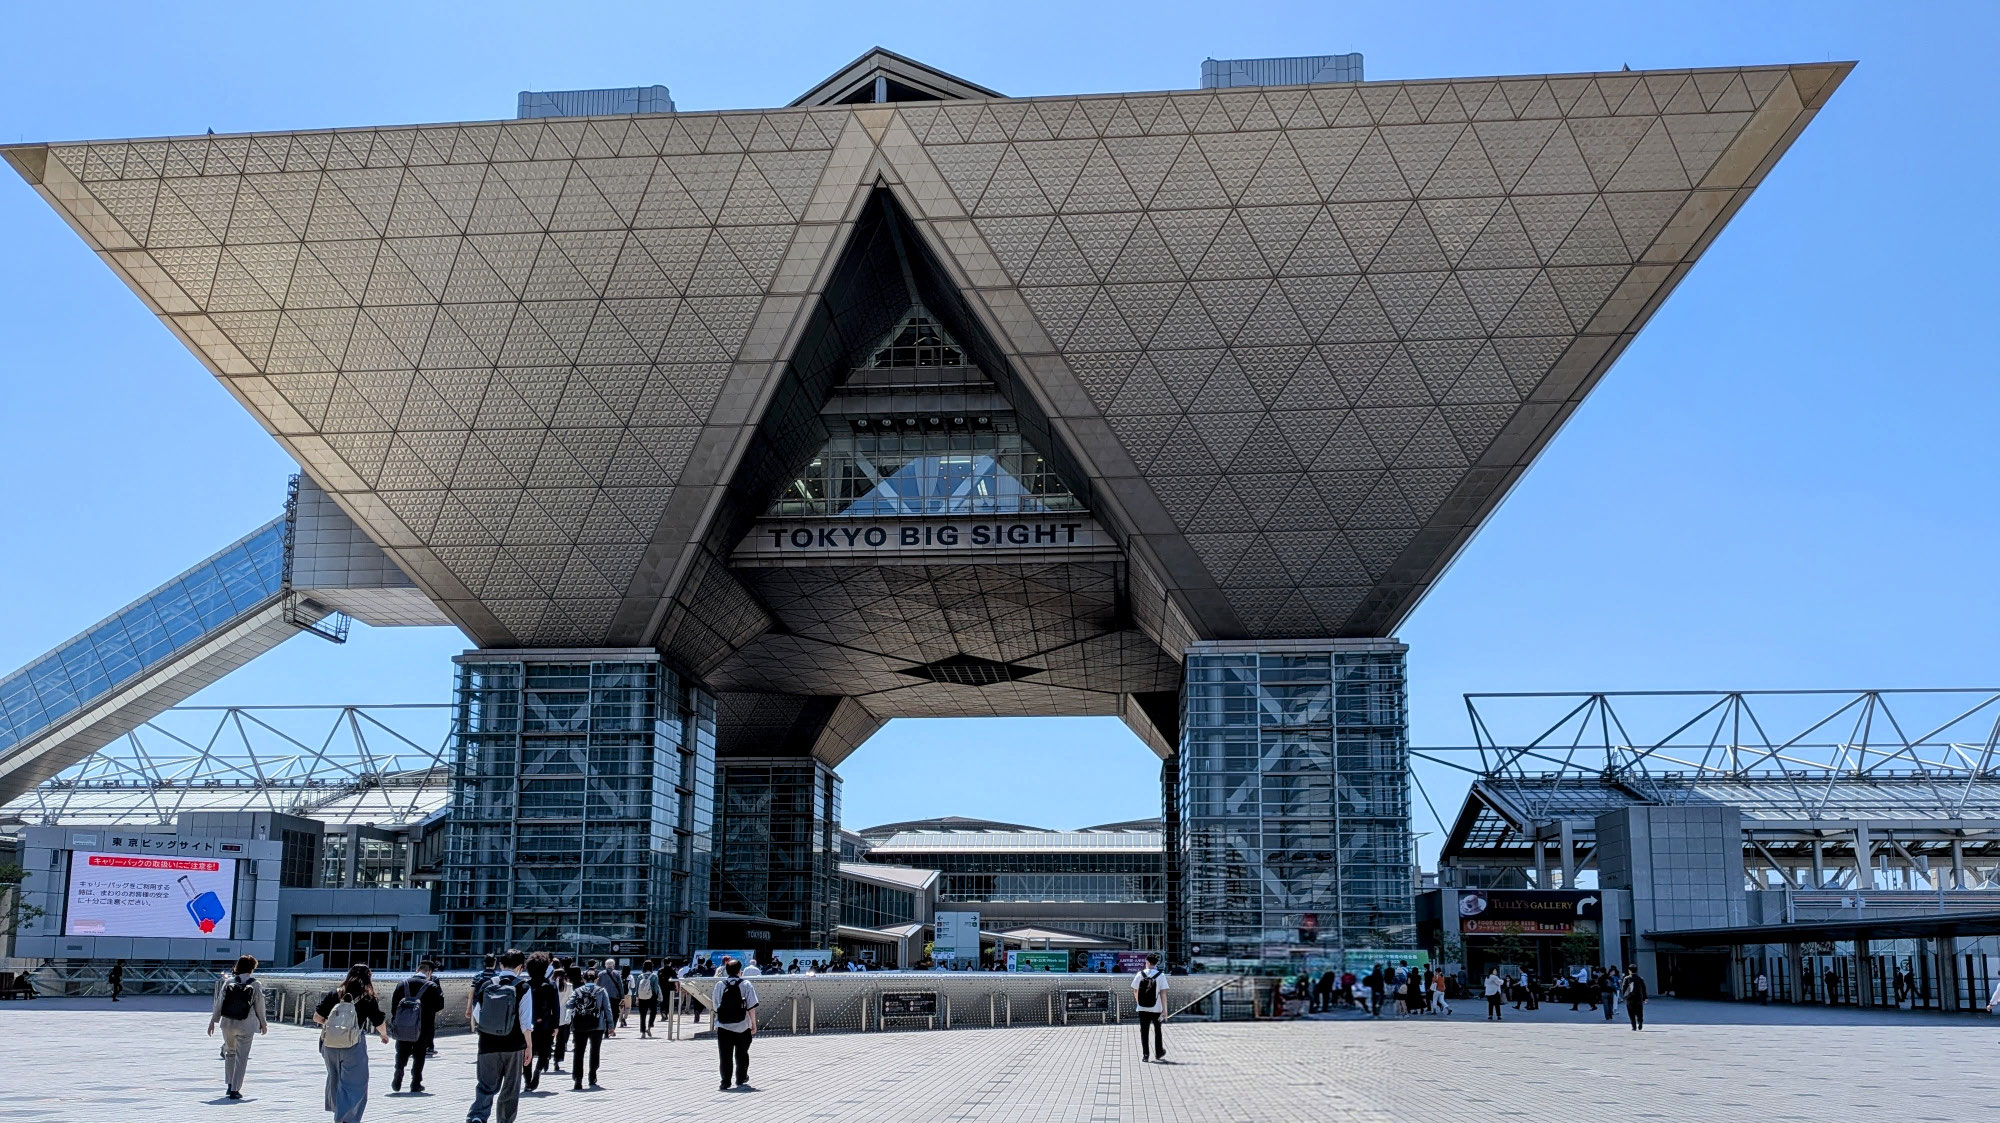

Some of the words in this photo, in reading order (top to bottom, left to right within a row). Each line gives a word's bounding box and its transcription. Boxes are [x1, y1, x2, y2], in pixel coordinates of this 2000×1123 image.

[768, 526, 887, 548] TOKYO
[900, 525, 959, 547] BIG
[971, 523, 1082, 545] SIGHT
[112, 837, 213, 851] 東京ビッグサイト
[1530, 901, 1573, 909] GALLERY
